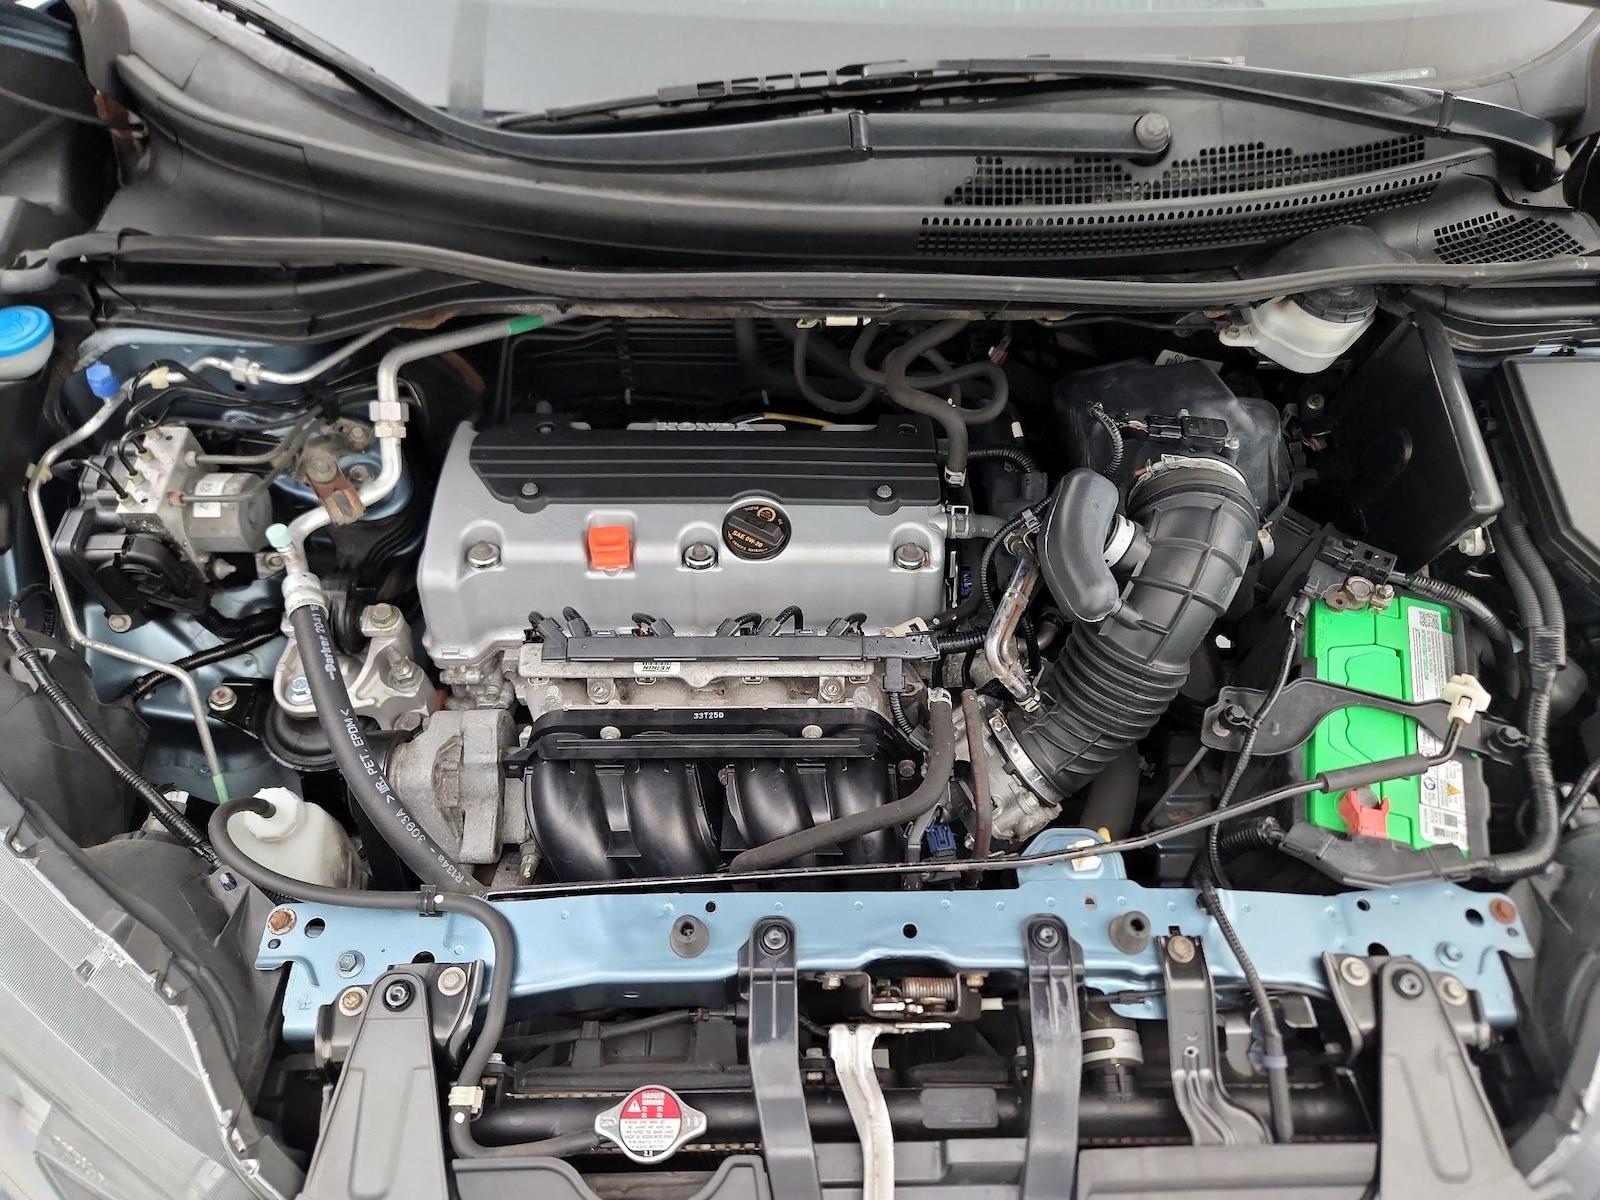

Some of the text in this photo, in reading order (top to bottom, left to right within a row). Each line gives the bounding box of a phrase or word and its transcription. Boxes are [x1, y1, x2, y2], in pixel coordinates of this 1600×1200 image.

[656, 421, 756, 431] HONDA
[732, 529, 745, 539] SAE
[396, 807, 426, 844] 3093A
